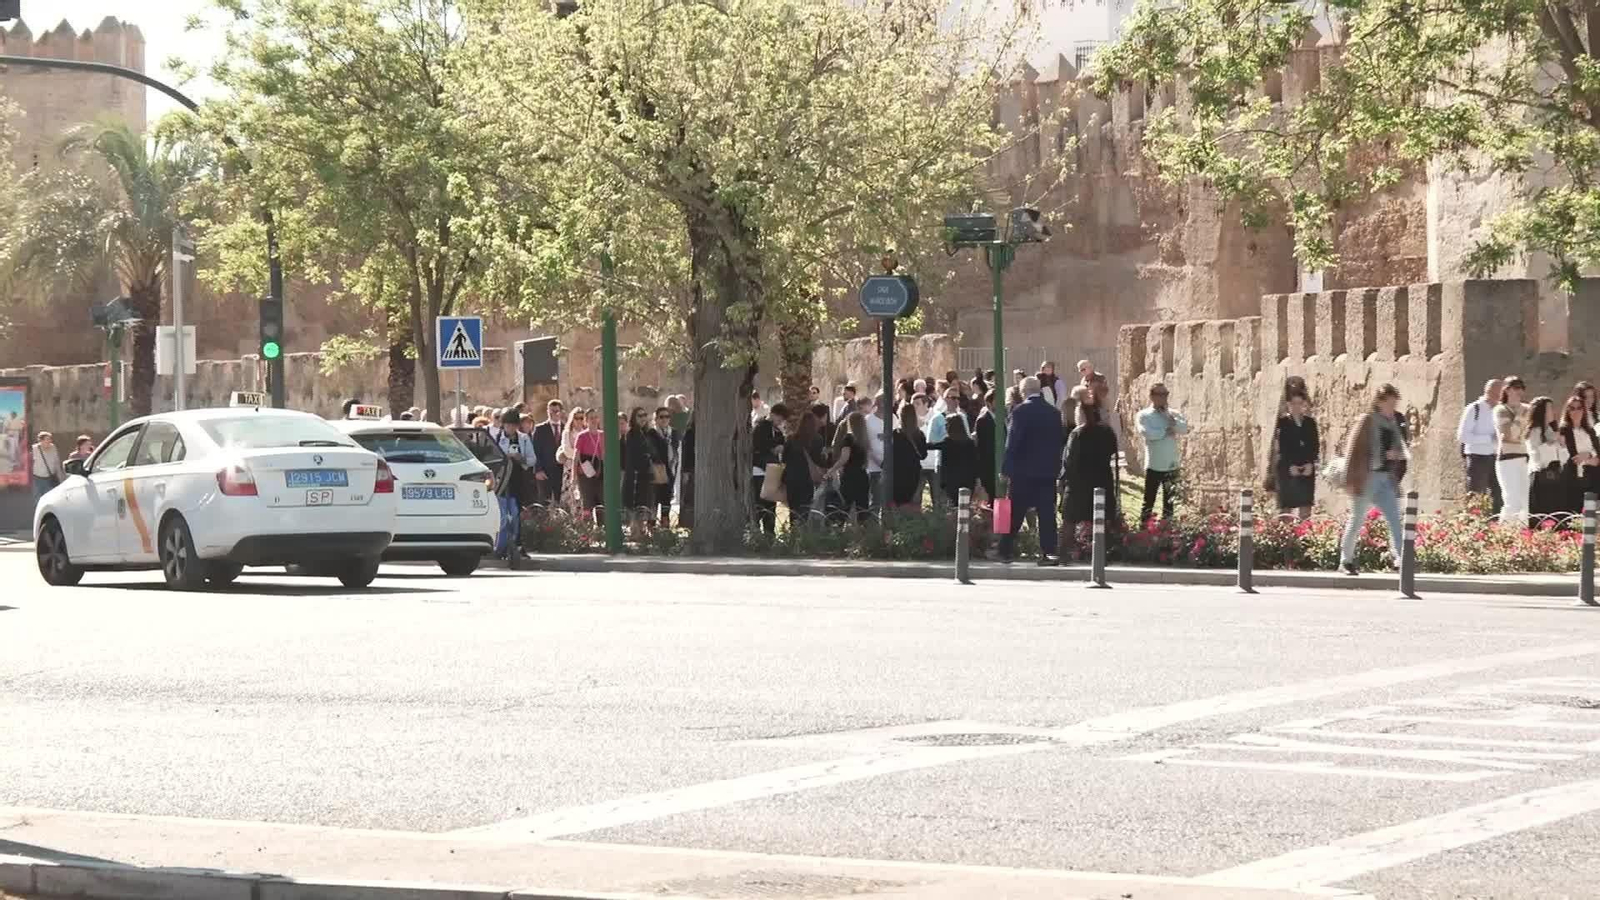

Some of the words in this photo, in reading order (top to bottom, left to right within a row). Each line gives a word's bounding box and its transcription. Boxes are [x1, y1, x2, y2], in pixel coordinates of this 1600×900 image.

[244, 393, 262, 405] TAXI
[309, 492, 330, 504] SP
[407, 487, 433, 499] 9579
[434, 487, 454, 499] LRB
